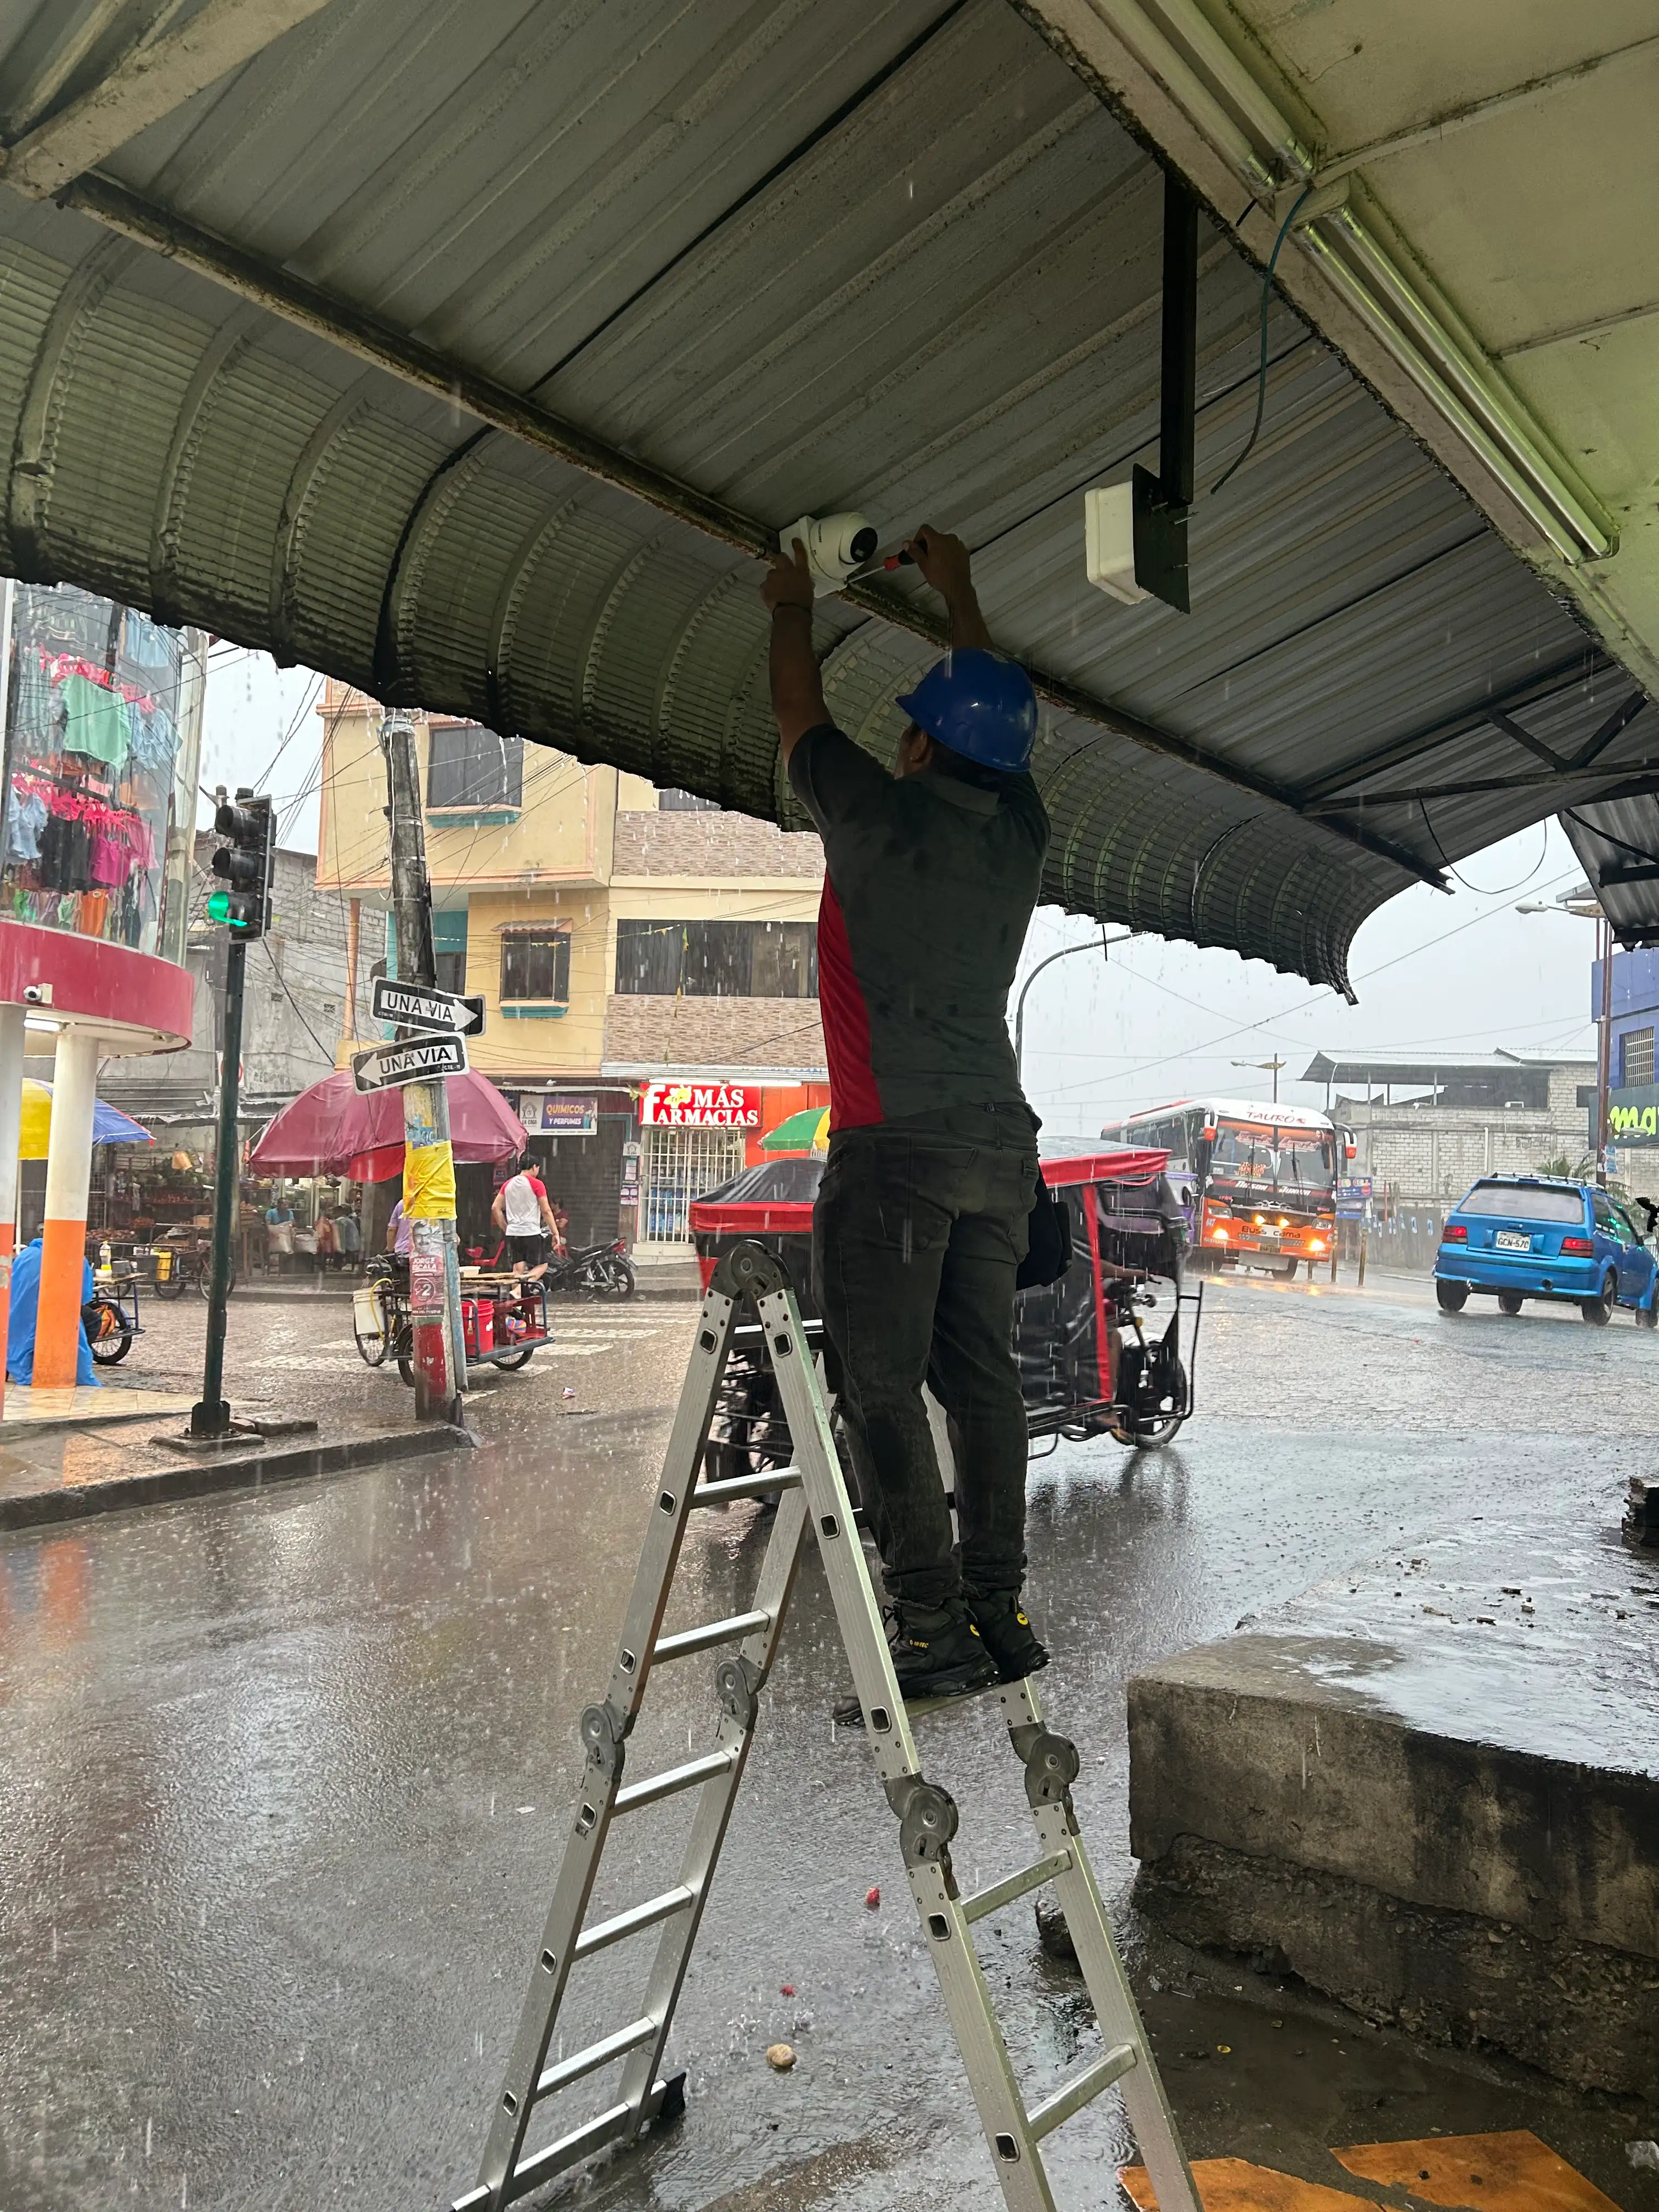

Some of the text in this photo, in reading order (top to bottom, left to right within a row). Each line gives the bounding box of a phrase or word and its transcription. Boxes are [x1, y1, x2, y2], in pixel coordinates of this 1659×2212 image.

[387, 992, 453, 1022] UNA VIA
[380, 1046, 452, 1074] UNA VIA
[641, 1084, 759, 1126] FARMACIAS
[692, 1086, 744, 1108] MÁS
[1246, 1111, 1295, 1123] TAURO
[1609, 1105, 1659, 1140] ma
[422, 1284, 431, 1296] 2
